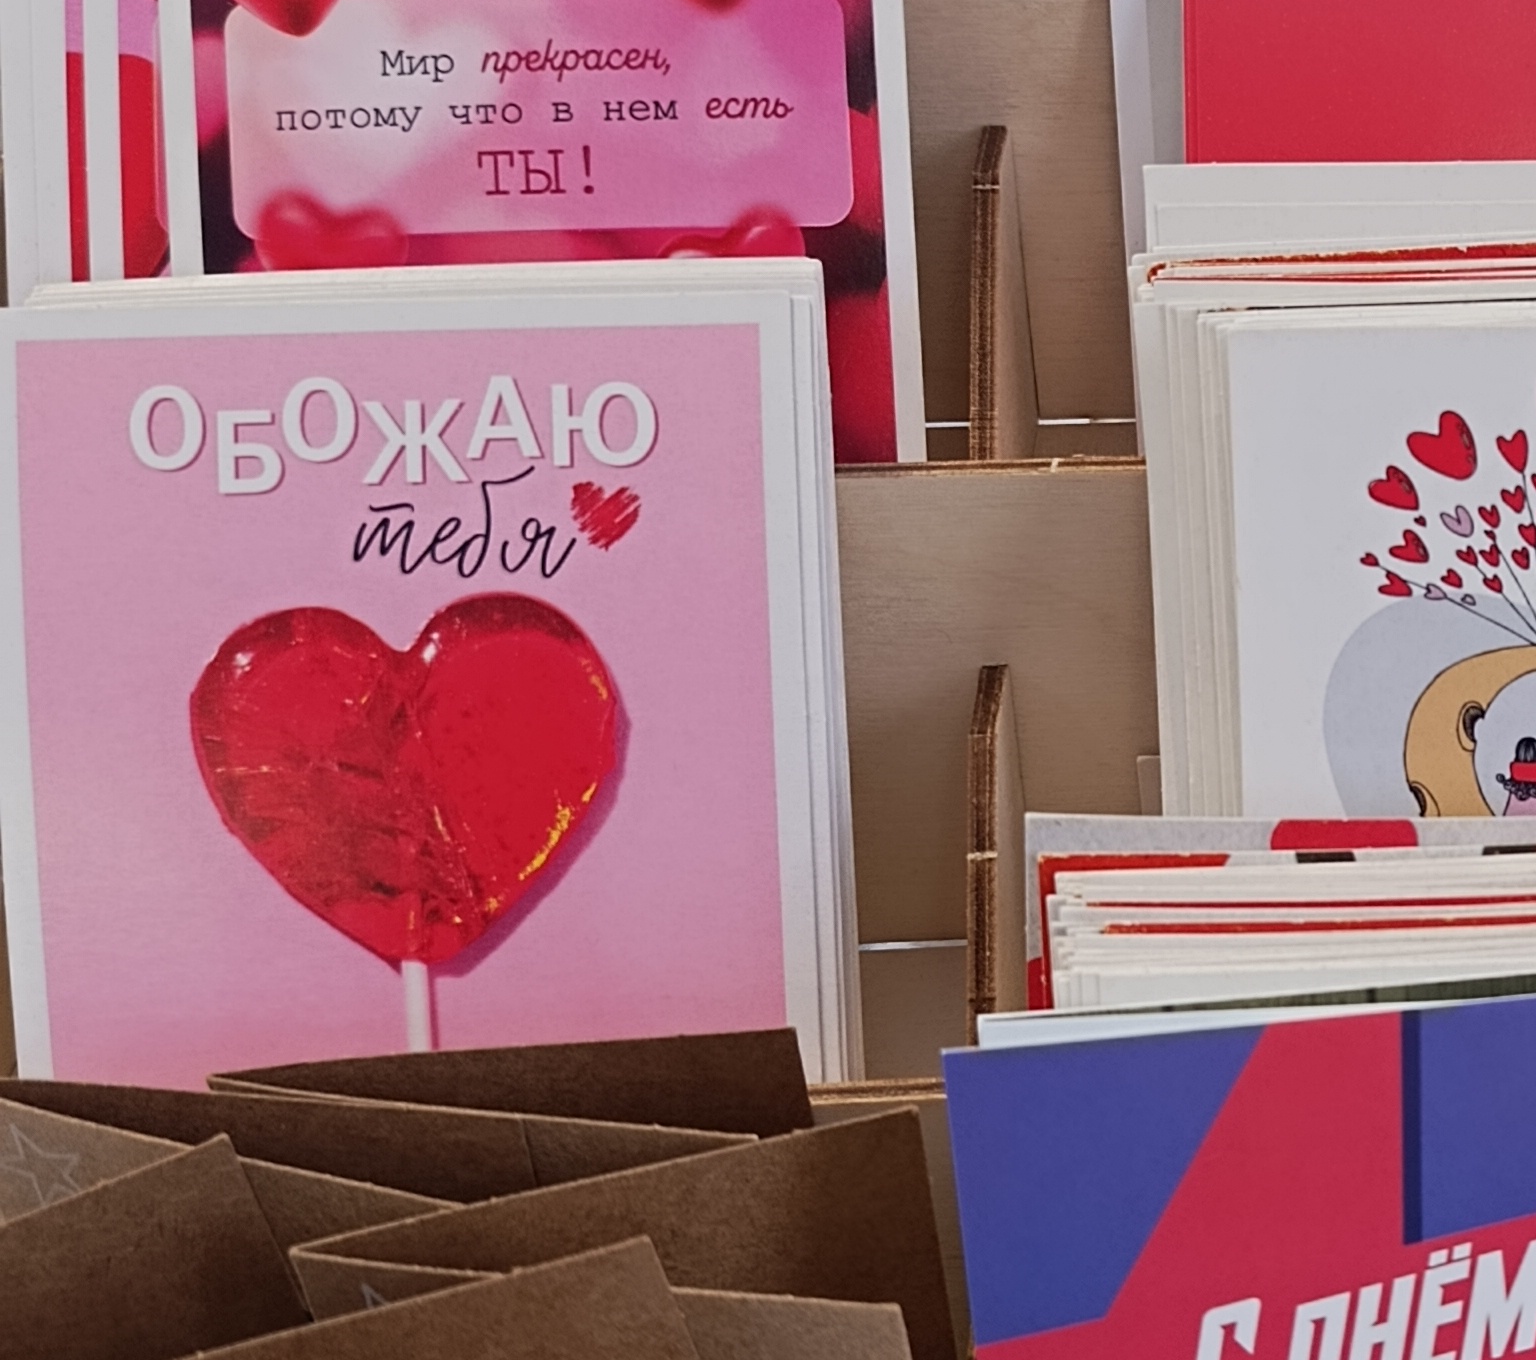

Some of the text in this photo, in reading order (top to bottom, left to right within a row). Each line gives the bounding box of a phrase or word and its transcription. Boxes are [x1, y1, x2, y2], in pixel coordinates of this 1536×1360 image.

[380, 39, 672, 84] Мир прекрасен,
[275, 94, 795, 133] потому что в нем есть
[477, 145, 596, 197] ТЫ!
[129, 375, 659, 496] ОБОЖАЮ
[352, 466, 578, 578] тебя
